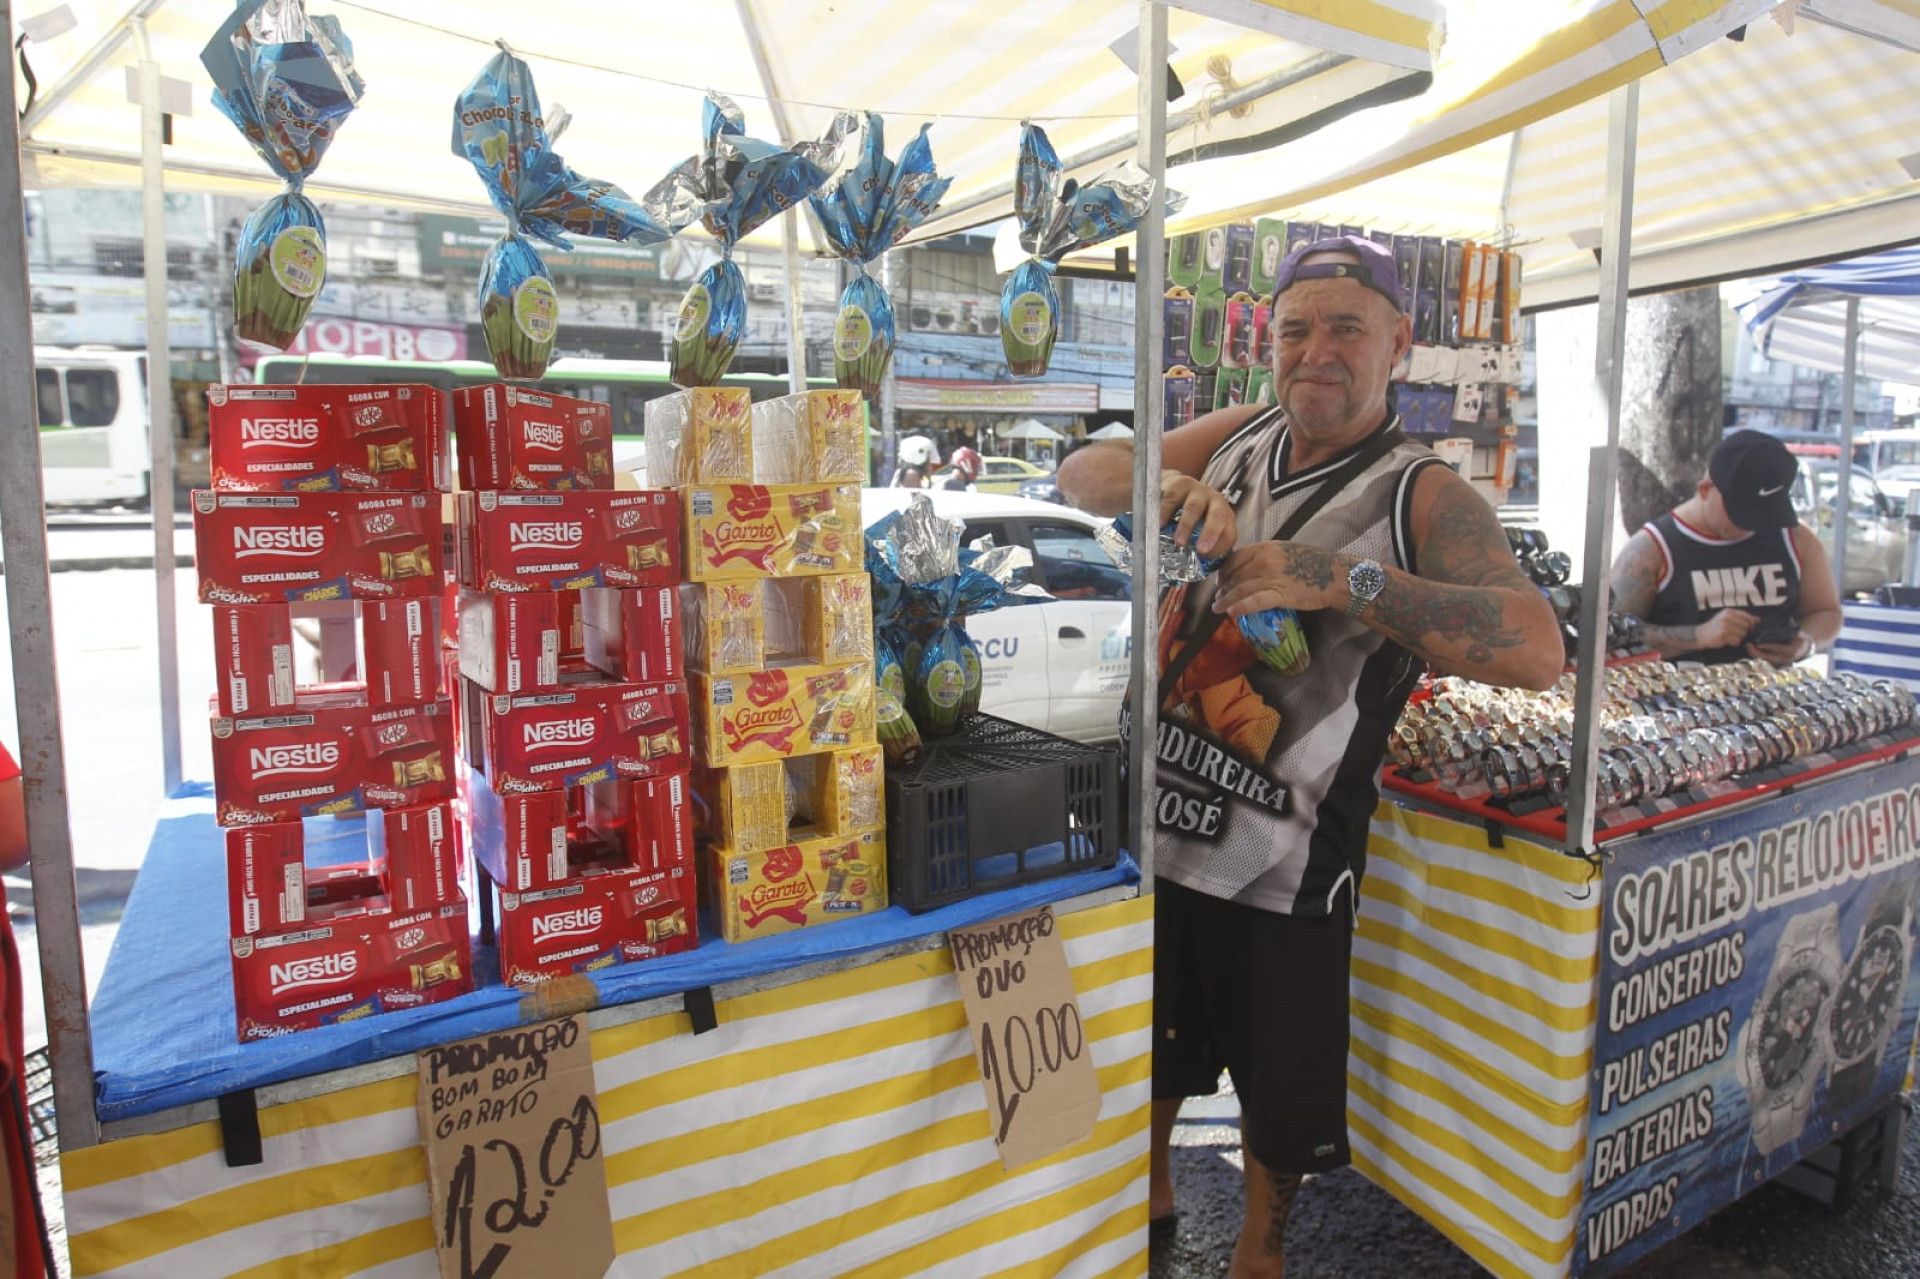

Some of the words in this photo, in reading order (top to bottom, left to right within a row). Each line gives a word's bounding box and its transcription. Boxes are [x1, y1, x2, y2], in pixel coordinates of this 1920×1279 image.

[348, 392, 373, 402] AGORA
[374, 391, 389, 399] COM
[247, 462, 313, 472] ESPECIALIDADES
[358, 501, 385, 510] AGORA
[386, 498, 402, 507] COM
[717, 521, 775, 541] Garoto
[242, 571, 319, 583] ESPECIALIDADES
[517, 563, 579, 574] ESPECIALIDADES
[1691, 563, 1787, 611] NIKE
[622, 690, 643, 700] AGORA
[644, 687, 658, 696] COM
[372, 710, 398, 722] AGORA
[399, 708, 415, 718] COM
[736, 708, 792, 728] Garoto
[531, 757, 591, 773] ESPECIALIDADES
[259, 785, 334, 803] ESPECIALIDADES
[752, 880, 806, 905] Garoto
[1612, 840, 1754, 966] SOARES
[389, 916, 414, 929] AGORA
[416, 912, 432, 923] COM
[539, 944, 599, 964] ESPECIALIDADES
[976, 959, 1026, 998] OVO
[1608, 931, 1745, 1033] CONSERTOS
[279, 993, 353, 1017] ESPECIALIDADES
[1599, 1009, 1731, 1113] PULSEIRAS
[981, 1002, 1082, 1144] 10.00
[432, 1078, 479, 1114] BOM
[436, 1082, 539, 1139] GARATO
[1592, 1087, 1714, 1189] BATERIAS
[1587, 1177, 1678, 1262] VIDROS
